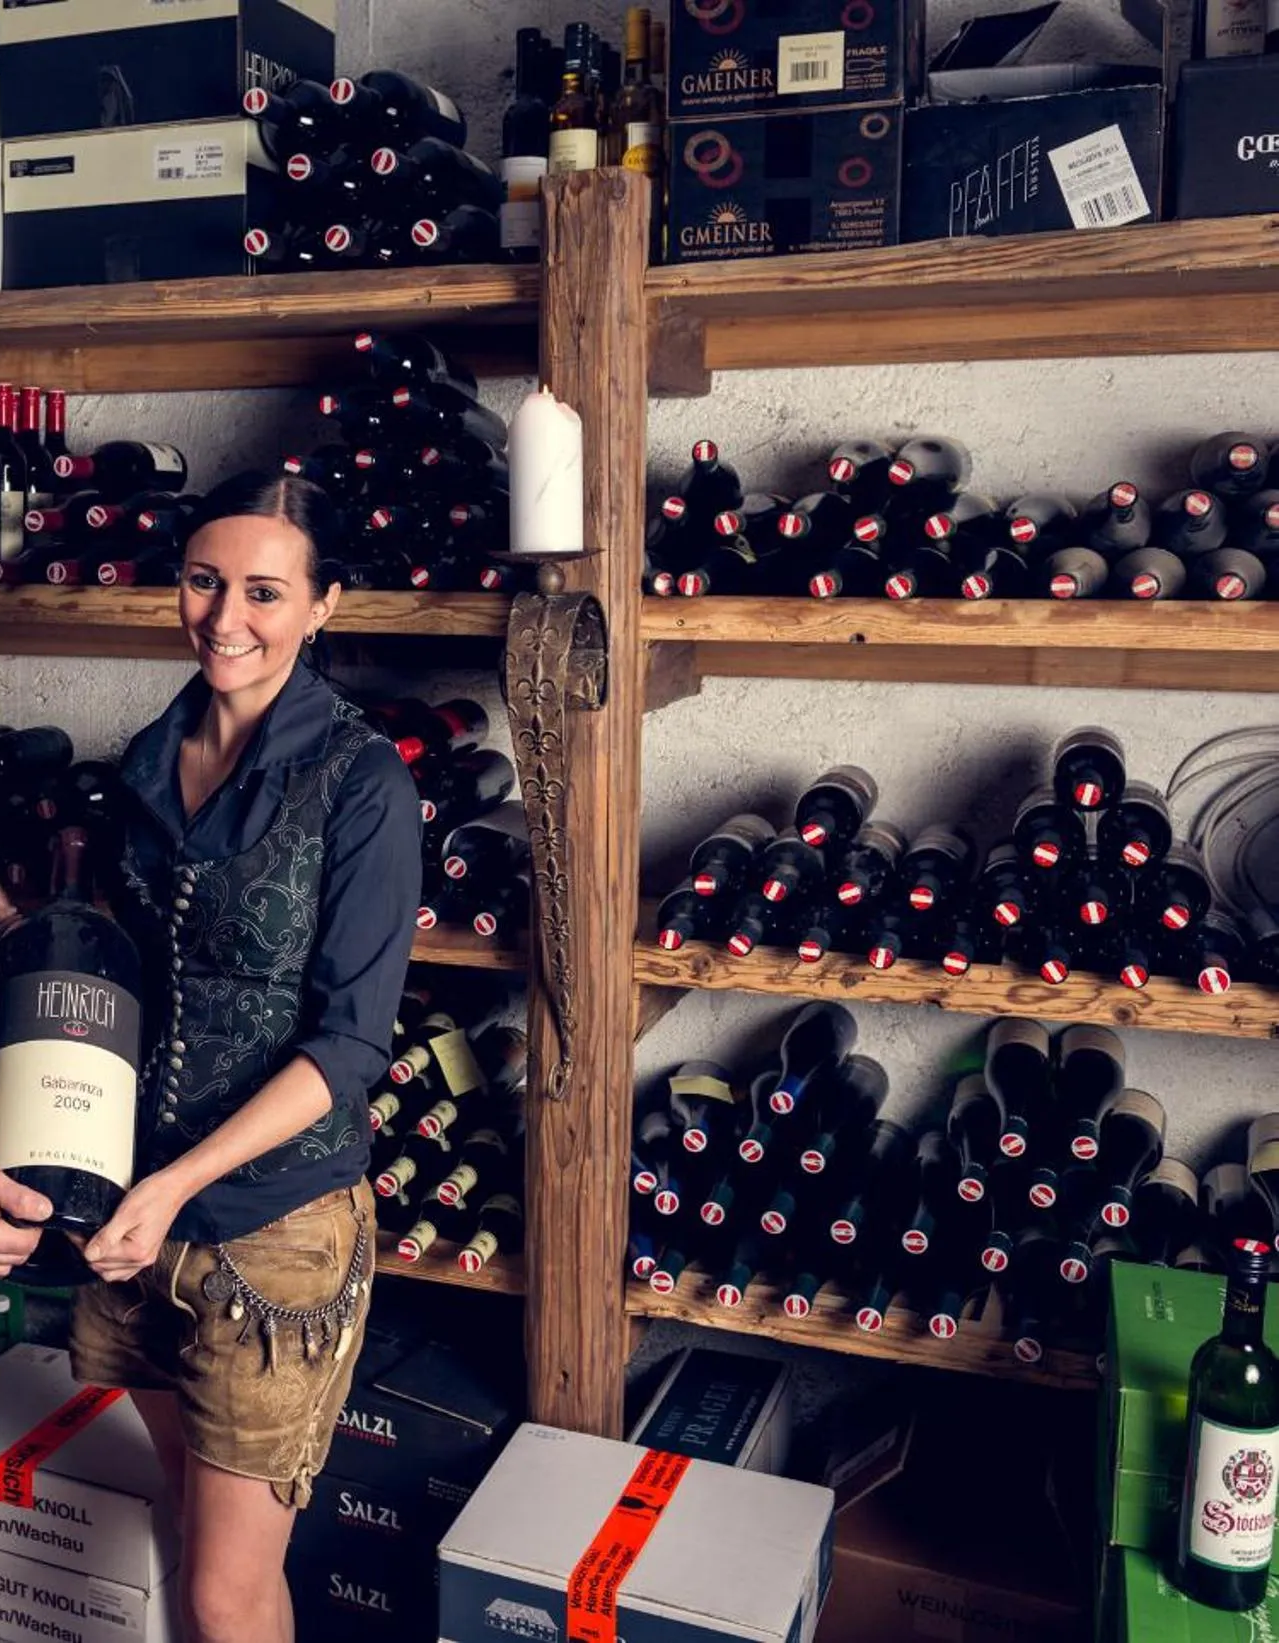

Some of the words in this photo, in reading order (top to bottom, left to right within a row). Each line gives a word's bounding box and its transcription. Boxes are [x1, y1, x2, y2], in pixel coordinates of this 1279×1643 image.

[846, 45, 887, 57] FRAGILE
[681, 67, 773, 95] GMEINER
[680, 222, 773, 246] GMEINER
[36, 981, 116, 1031] HEINRICH
[41, 1075, 103, 1098] Gabarinza
[53, 1095, 91, 1113] 2009
[335, 1404, 398, 1440] SALZL
[680, 1380, 739, 1447] PRAGER
[32, 1496, 93, 1526] KNOLL
[338, 1491, 402, 1530] SALZL
[32, 1587, 87, 1618] KNOLL
[328, 1573, 392, 1612] SALZL
